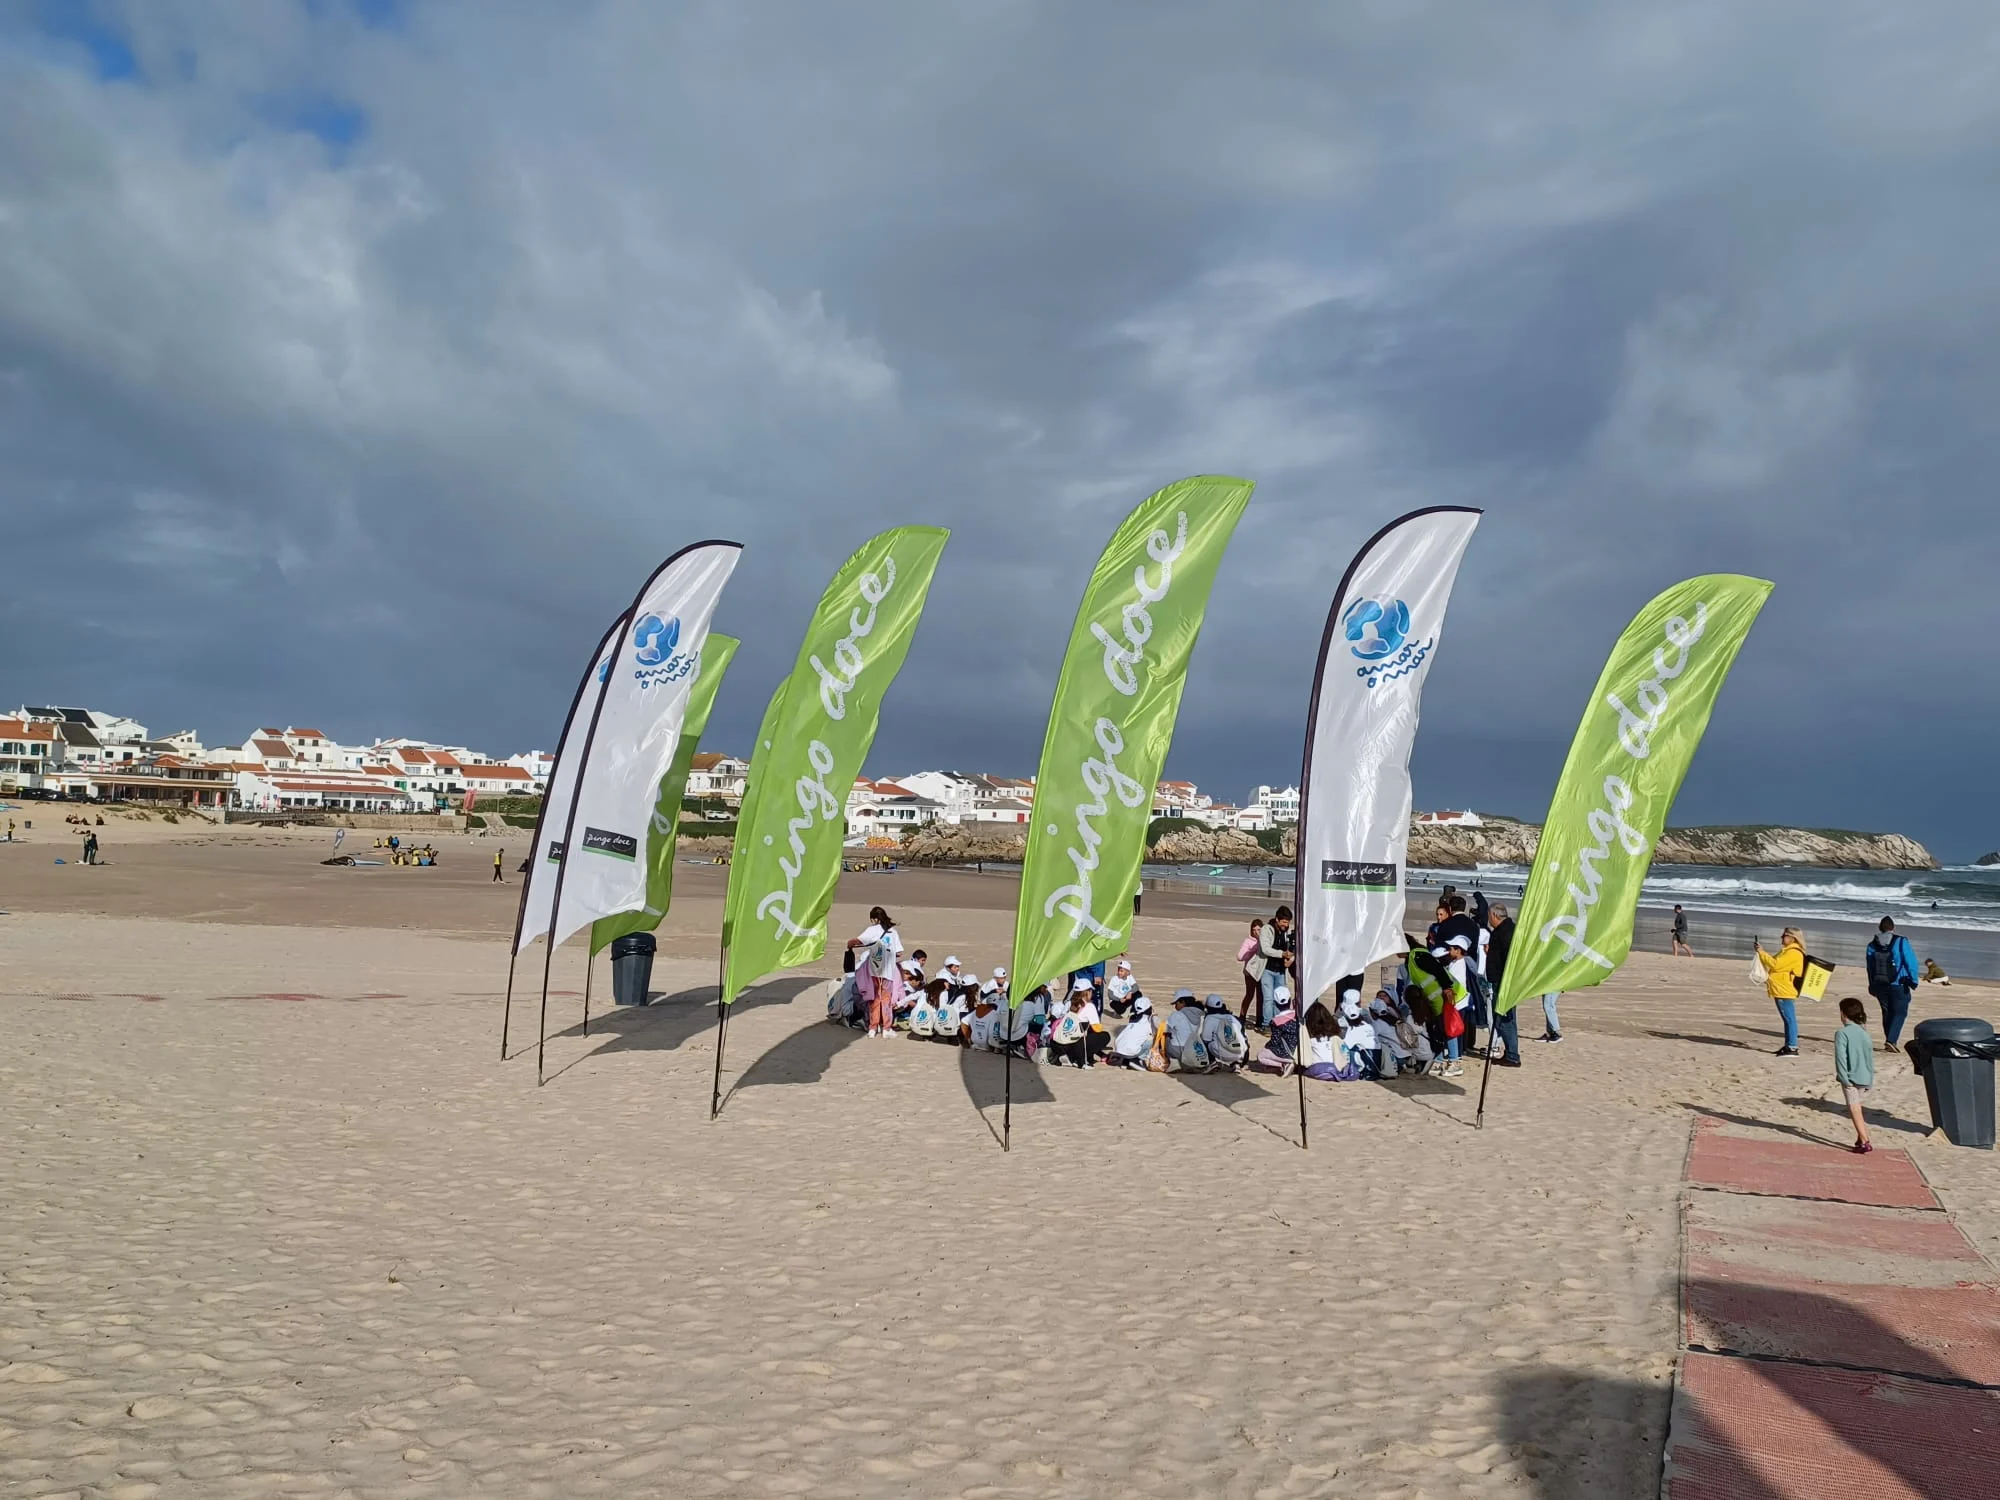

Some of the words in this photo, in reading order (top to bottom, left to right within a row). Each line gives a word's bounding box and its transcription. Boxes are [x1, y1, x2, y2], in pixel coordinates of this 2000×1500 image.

[1090, 511, 1188, 696] doce
[634, 653, 686, 679] amar
[654, 651, 698, 686] mar
[1357, 639, 1420, 677] amar
[1367, 677, 1377, 688] o
[1383, 637, 1433, 682] mar
[756, 739, 838, 941] pingo
[809, 555, 897, 720] doce
[1540, 775, 1648, 969] pingo
[1607, 601, 1707, 759] doce
[586, 833, 611, 846] pingo
[612, 835, 631, 846] doce
[1044, 717, 1146, 939] pingo
[1326, 866, 1358, 881] pingo
[1360, 865, 1387, 876] doce
